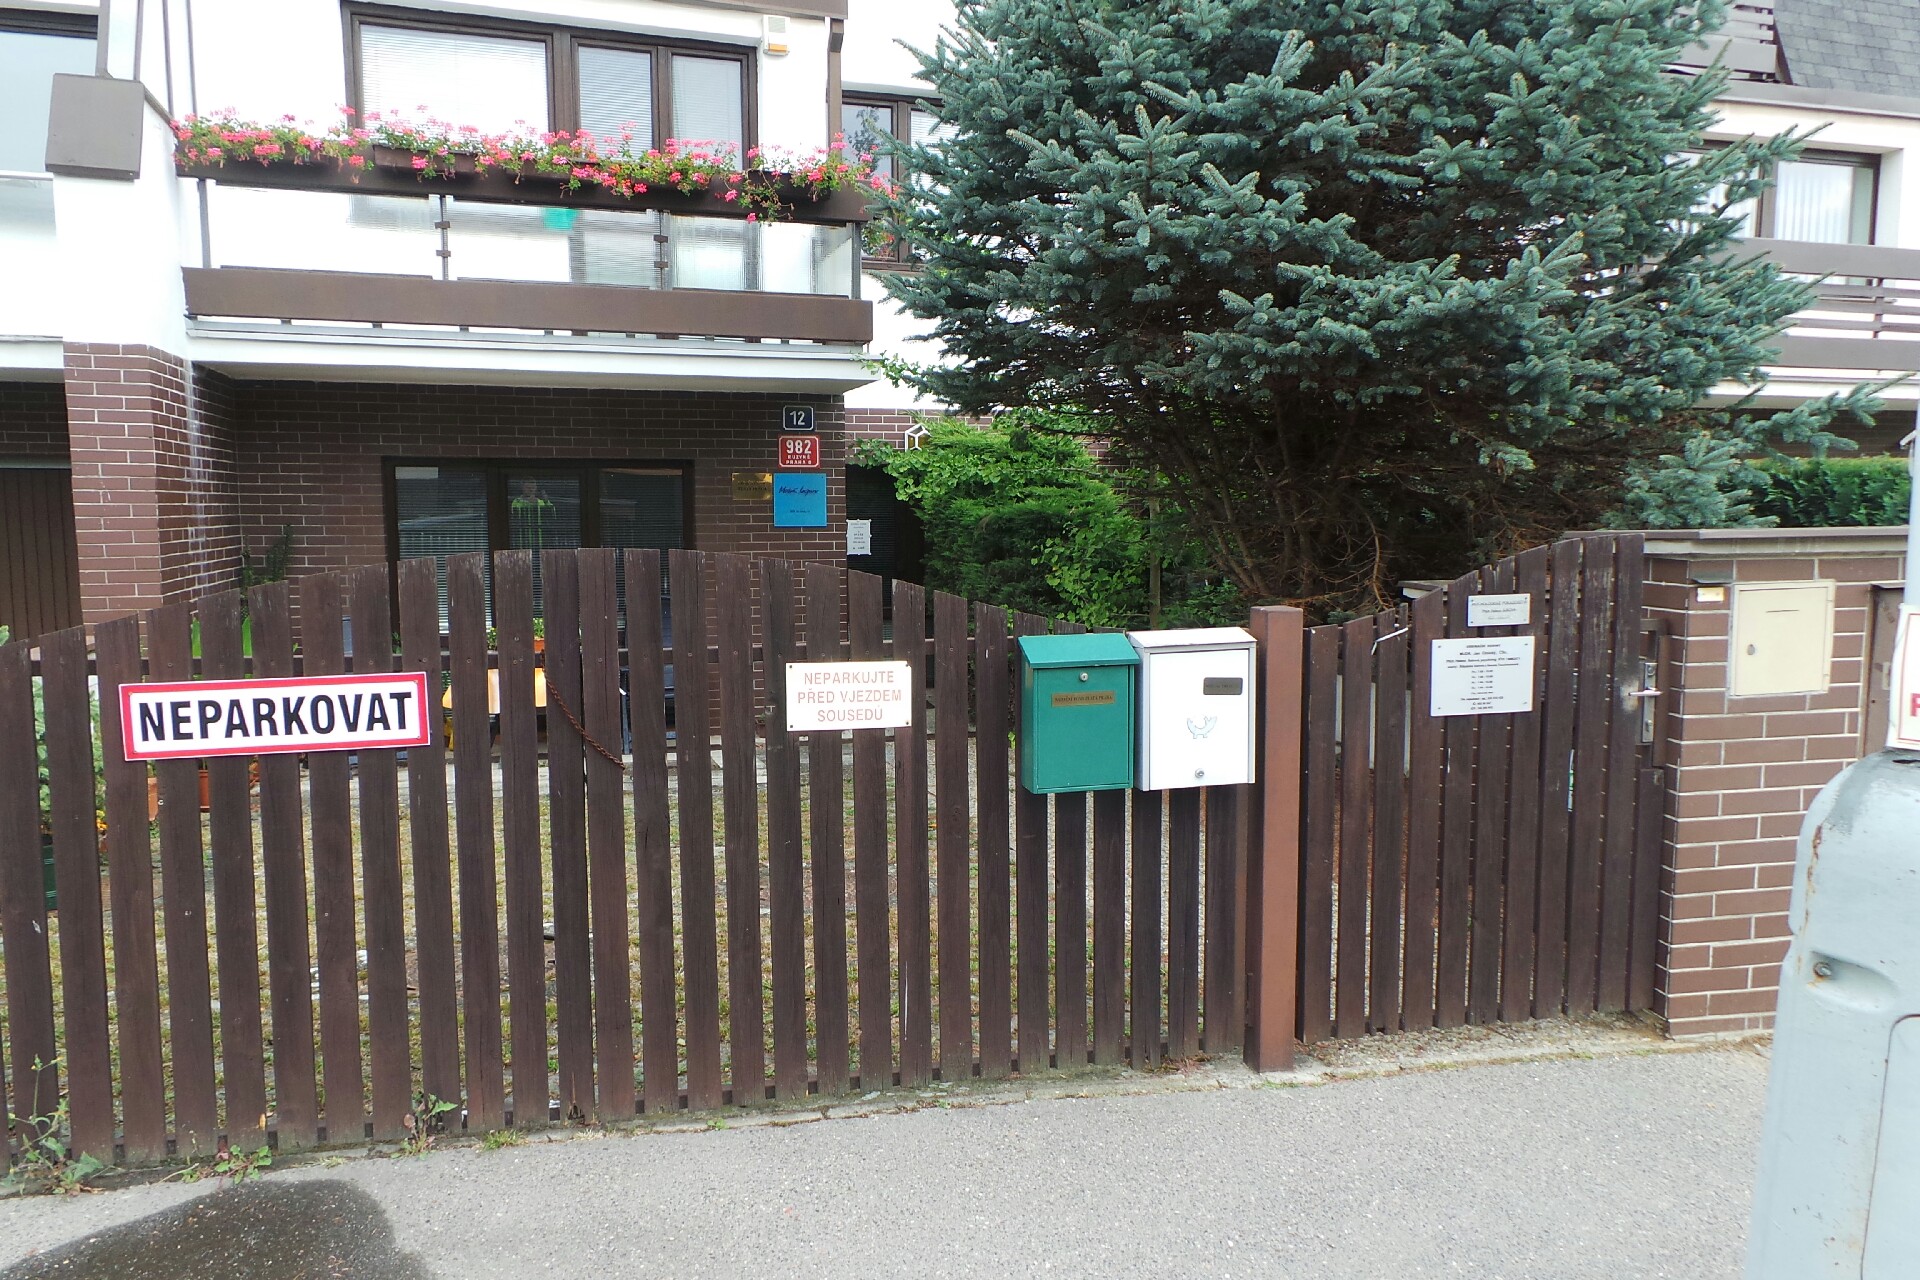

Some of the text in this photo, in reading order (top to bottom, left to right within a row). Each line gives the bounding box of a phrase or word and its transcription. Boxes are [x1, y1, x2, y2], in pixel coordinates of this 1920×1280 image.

[790, 411, 805, 426] 12
[786, 440, 812, 454] 982
[804, 670, 894, 685] NEPARKUJTE
[797, 688, 902, 704] PŘED VJEZDEM
[138, 691, 412, 742] NEPARKOVAT
[817, 704, 883, 722] SOUSEDŮ
